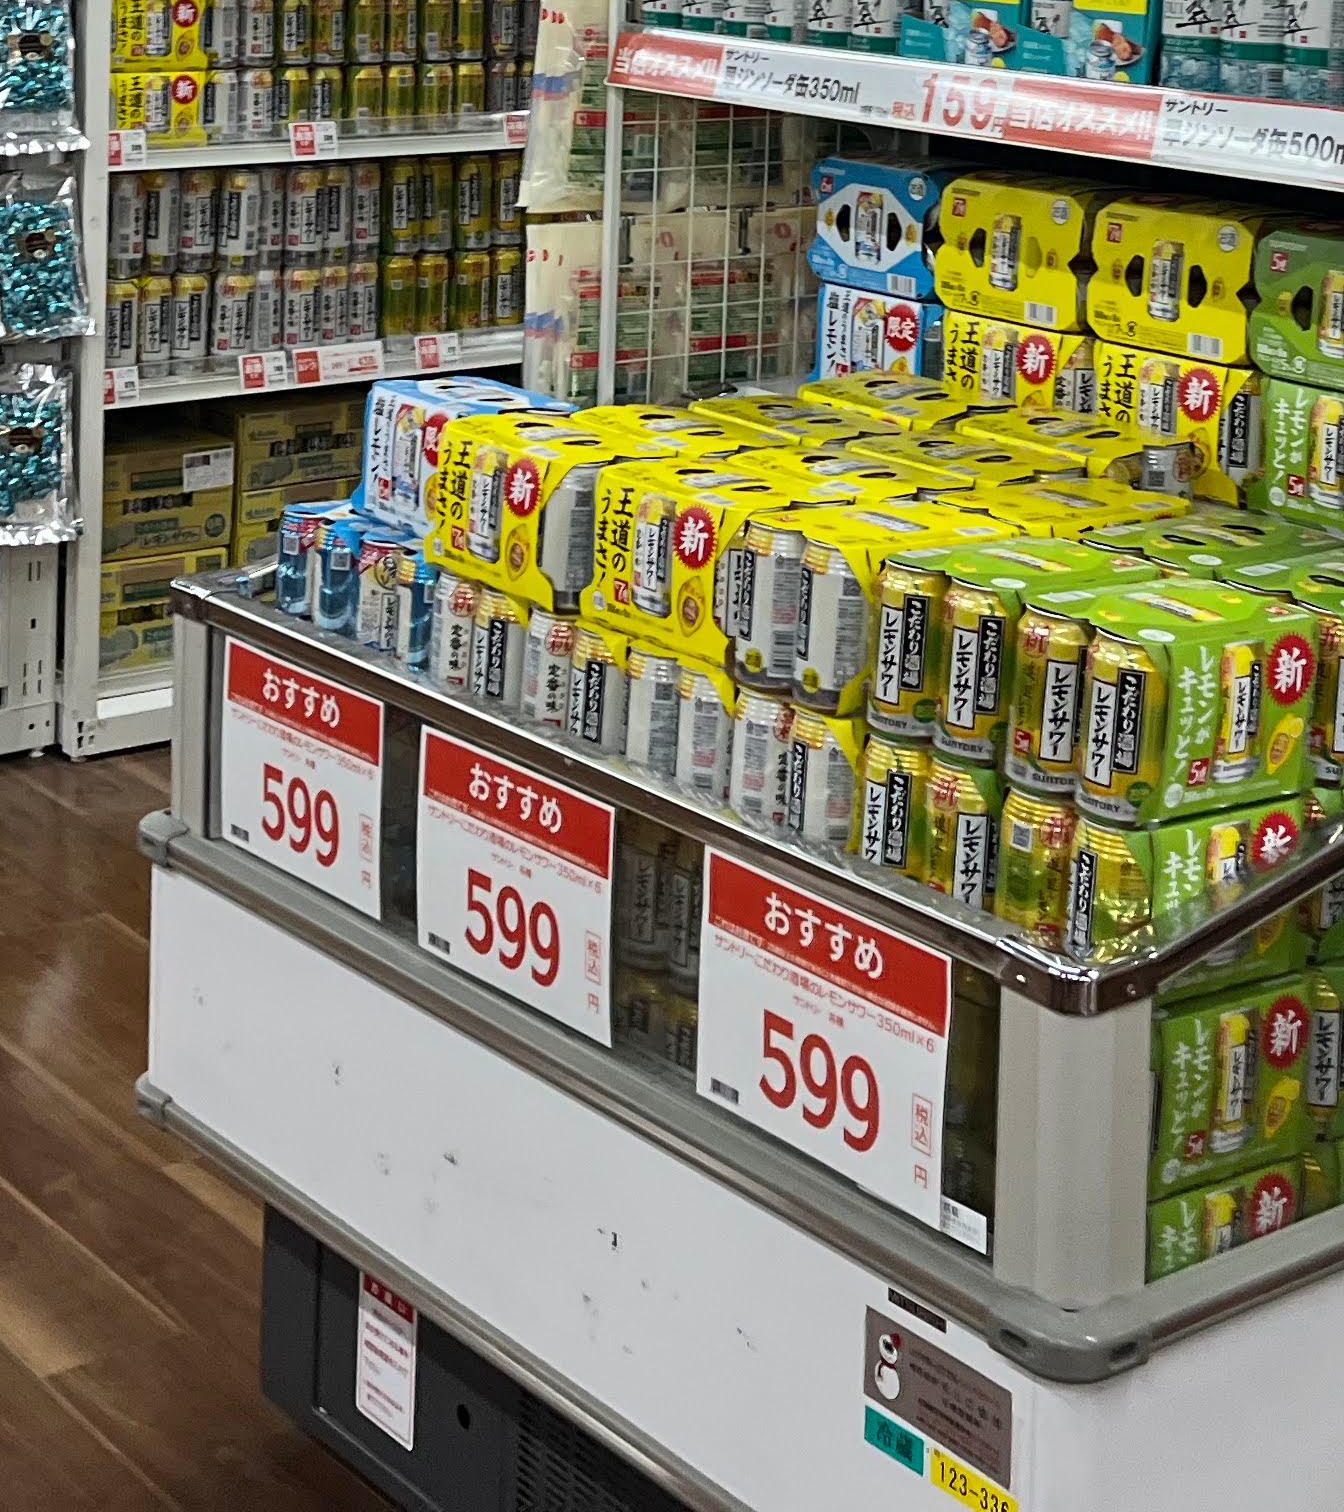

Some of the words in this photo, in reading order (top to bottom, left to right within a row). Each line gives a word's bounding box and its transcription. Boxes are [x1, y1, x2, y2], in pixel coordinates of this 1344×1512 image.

[1165, 99, 1229, 116] サントリー
[960, 321, 981, 390] 王道の
[1022, 344, 1050, 378] 新
[1113, 352, 1137, 423] 王道の
[1182, 376, 1215, 413] 新
[451, 440, 475, 522] 王道の
[509, 467, 535, 511] 新
[611, 486, 636, 574] 王道の
[678, 515, 710, 563] 新
[879, 610, 900, 698] レモンサワー
[953, 633, 973, 723] レモンサワー
[1274, 645, 1308, 696] 新
[262, 668, 342, 729] おすすめ
[1046, 665, 1073, 757] レモンサワー
[1196, 644, 1217, 745] レモンが
[1231, 679, 1248, 752] レモンサワー
[1088, 685, 1112, 779] レモンサワー
[261, 761, 341, 868] 599
[467, 762, 564, 835] おすすめ
[958, 818, 985, 906] レモンサワー
[464, 867, 561, 988] 599
[763, 890, 885, 980] おすすめ
[586, 992, 601, 1016] 円
[1270, 1012, 1303, 1058] 新
[758, 1008, 881, 1153] 599
[914, 1102, 929, 1147] 税込
[913, 1163, 929, 1190] 円
